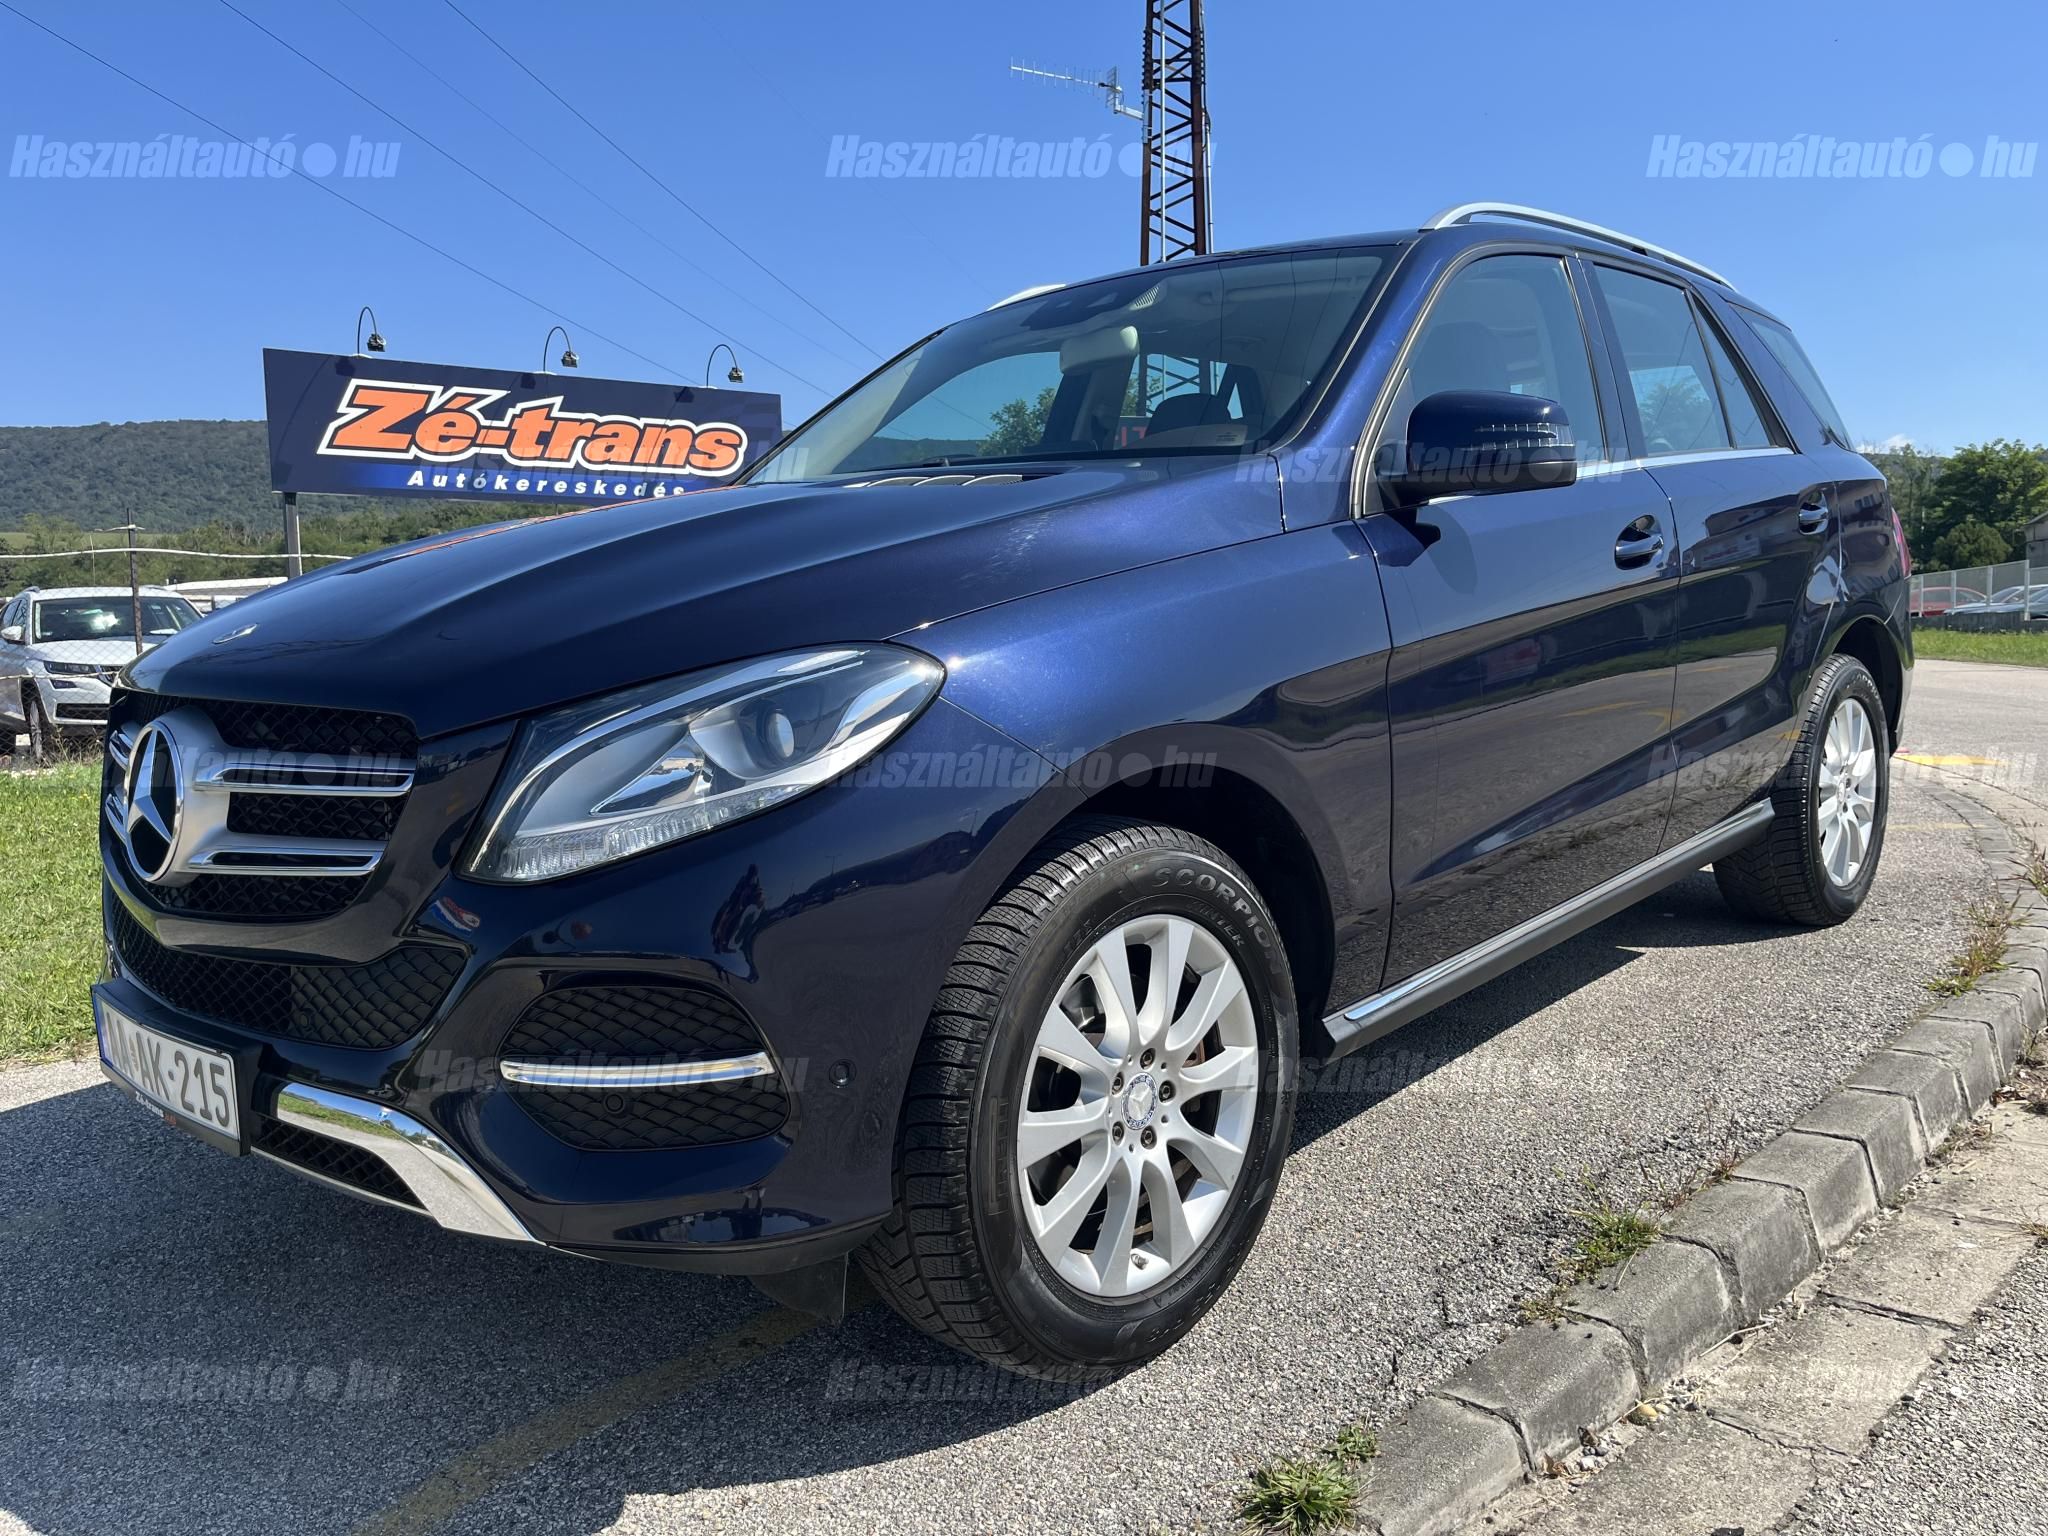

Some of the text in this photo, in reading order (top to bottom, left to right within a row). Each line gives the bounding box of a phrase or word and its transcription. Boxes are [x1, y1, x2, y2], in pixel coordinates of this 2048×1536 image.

[317, 379, 748, 475] Zé-trans
[407, 470, 685, 497] Autókereskedés
[1152, 867, 1282, 975] SCORPION
